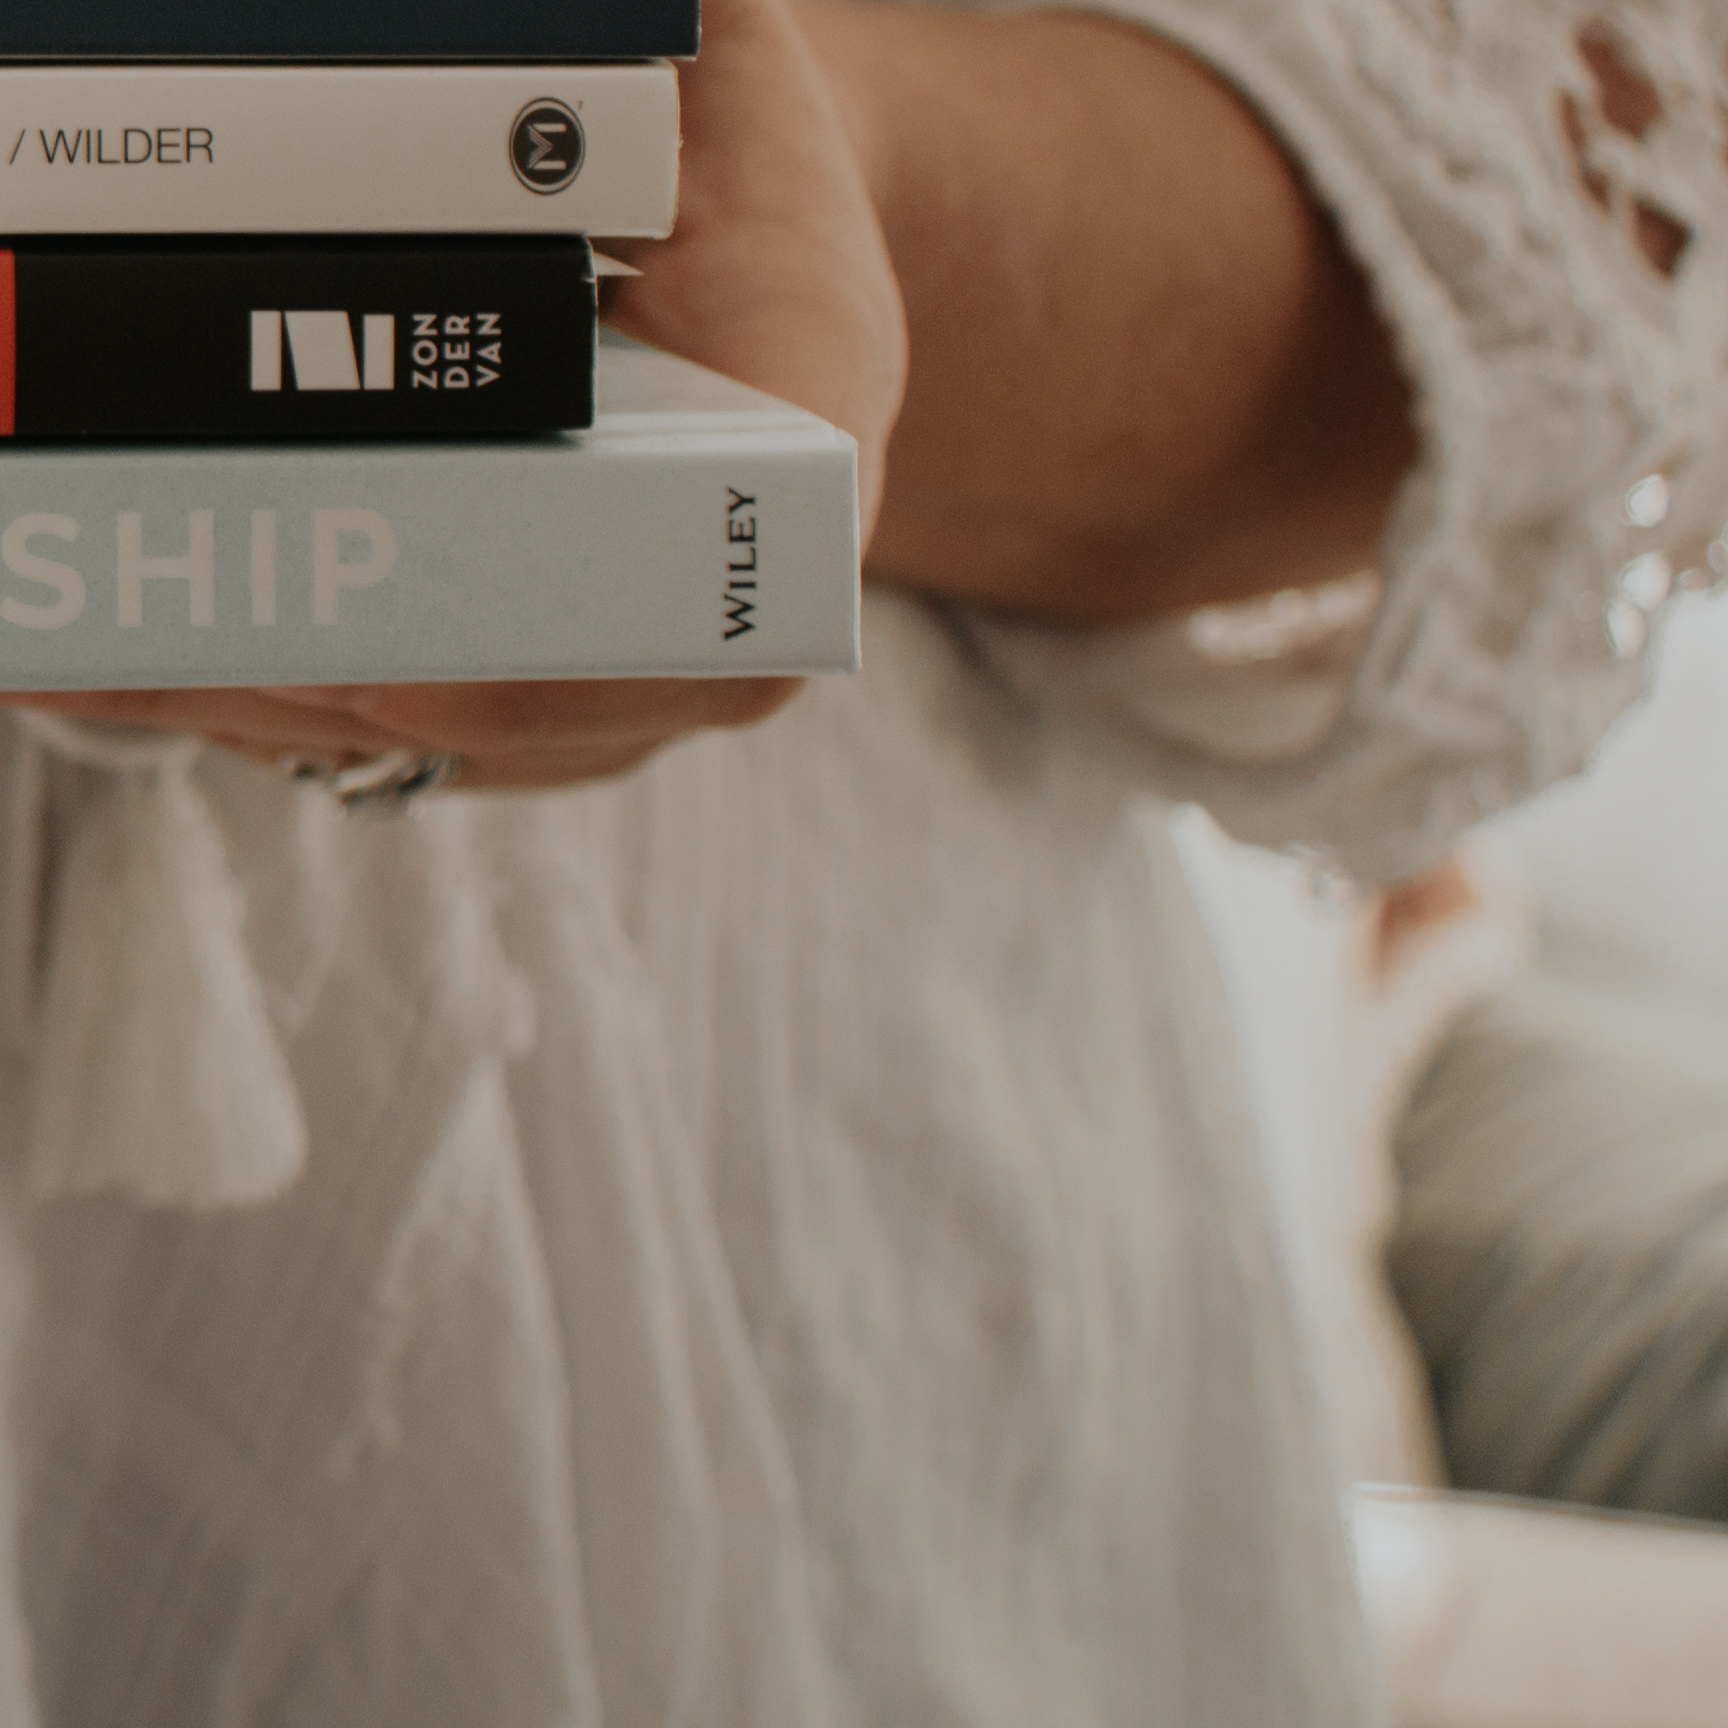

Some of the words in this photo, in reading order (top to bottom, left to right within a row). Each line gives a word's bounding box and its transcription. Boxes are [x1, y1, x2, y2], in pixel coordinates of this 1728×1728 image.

[38, 127, 214, 166] WILDER
[412, 313, 438, 390] ZON
[444, 315, 470, 389] DER
[476, 312, 502, 387] VAN
[722, 486, 757, 642] WILEY
